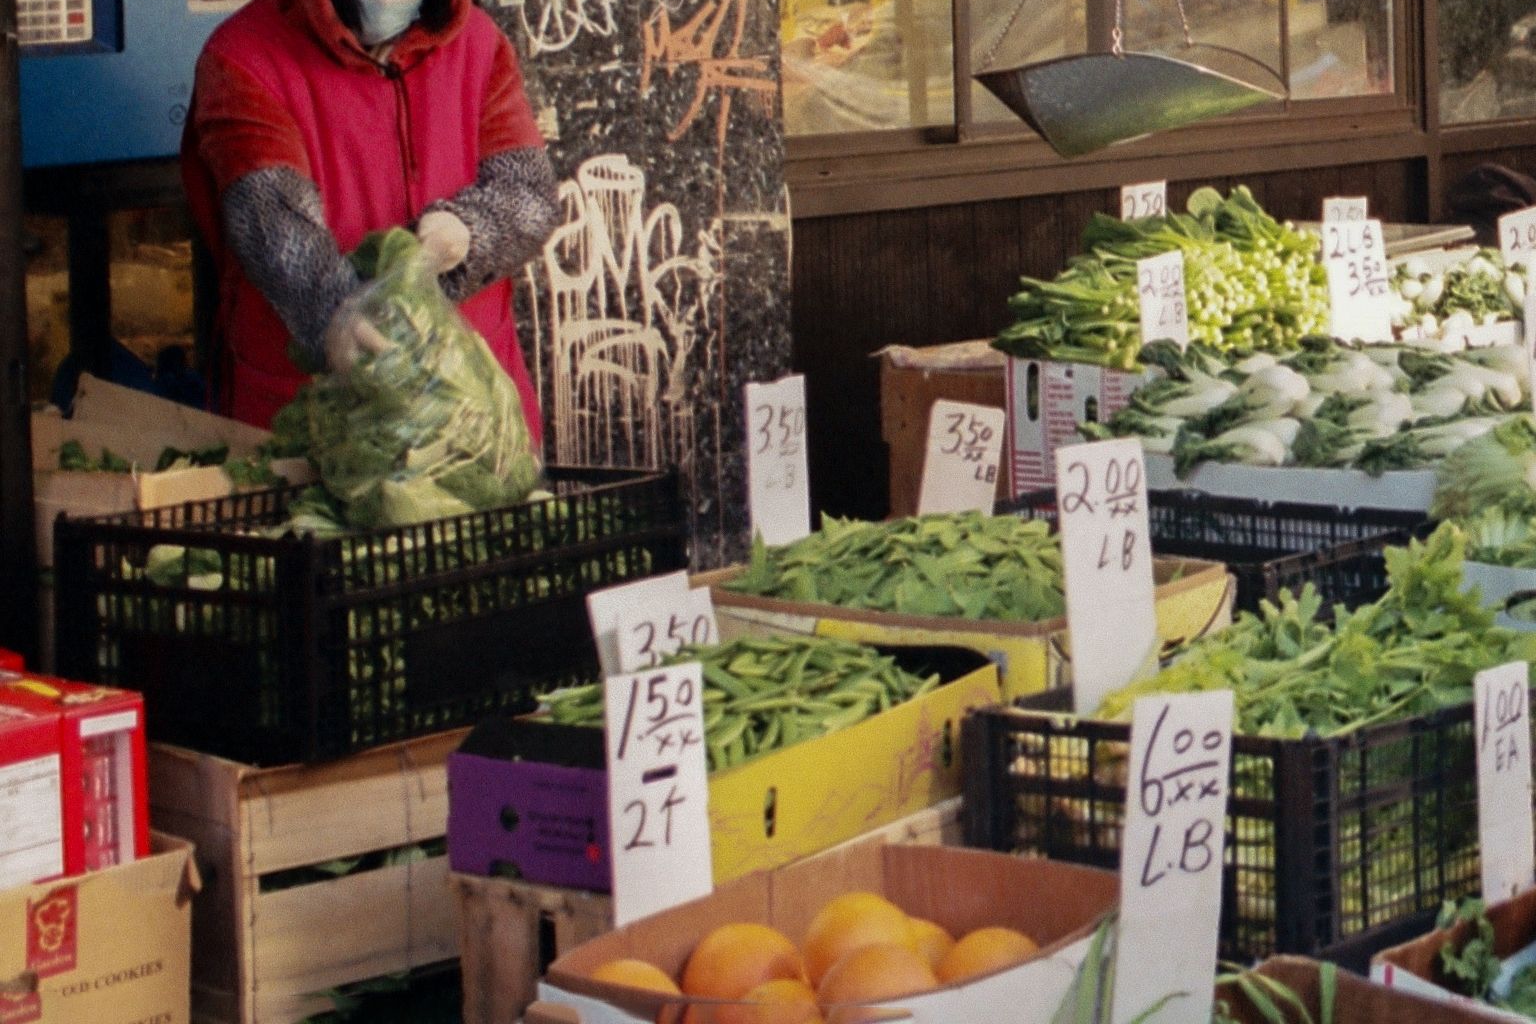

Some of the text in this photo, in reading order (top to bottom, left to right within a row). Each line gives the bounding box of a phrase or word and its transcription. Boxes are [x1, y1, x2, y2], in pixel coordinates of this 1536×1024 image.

[974, 464, 998, 484] LB
[1097, 529, 1136, 571] LB
[1494, 733, 1519, 772] EA
